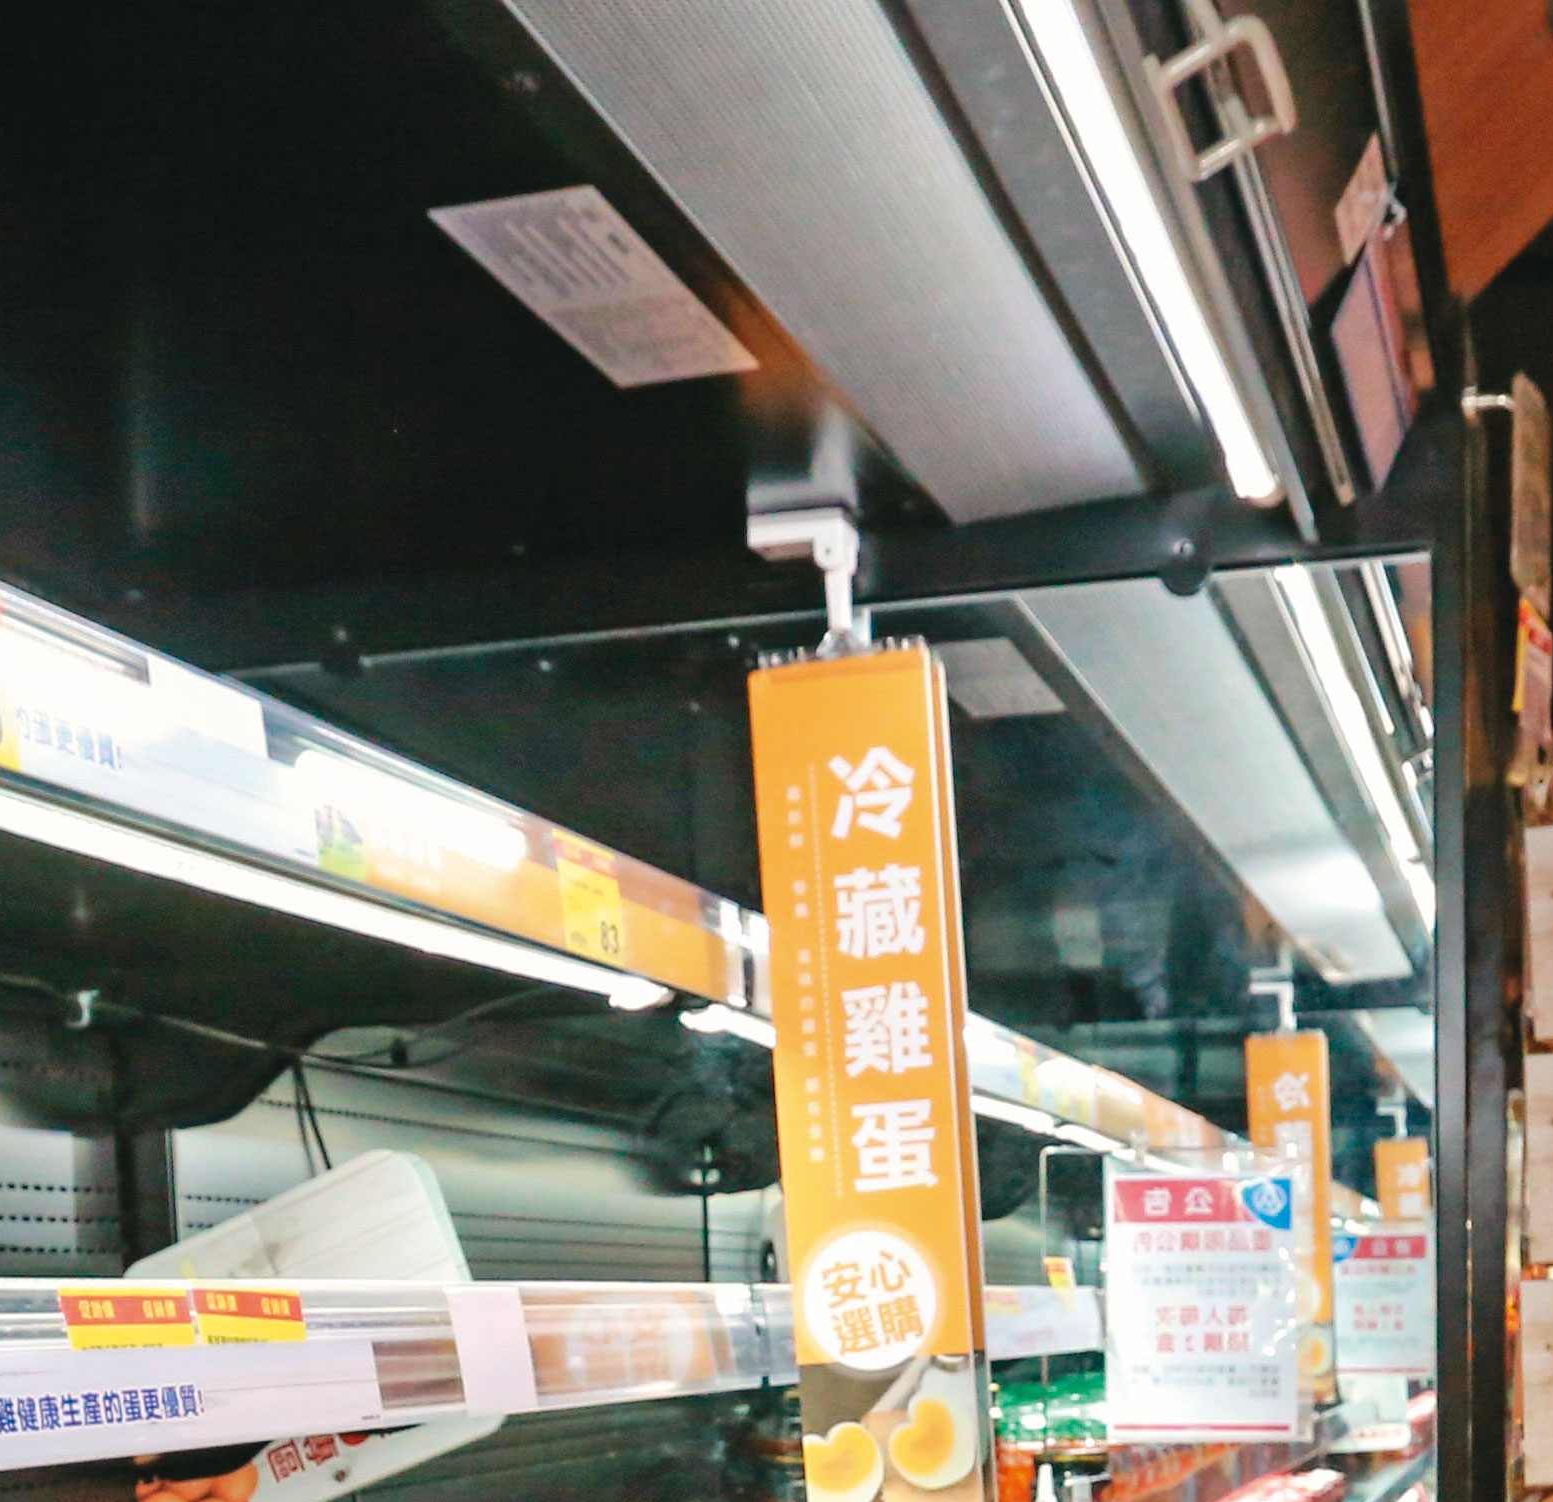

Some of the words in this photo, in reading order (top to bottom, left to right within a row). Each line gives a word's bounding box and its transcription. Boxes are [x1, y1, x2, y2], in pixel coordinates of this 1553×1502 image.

[827, 745, 939, 1194] 冷藏雞蛋
[820, 1248, 912, 1309] 安心
[831, 1296, 926, 1357] 選購
